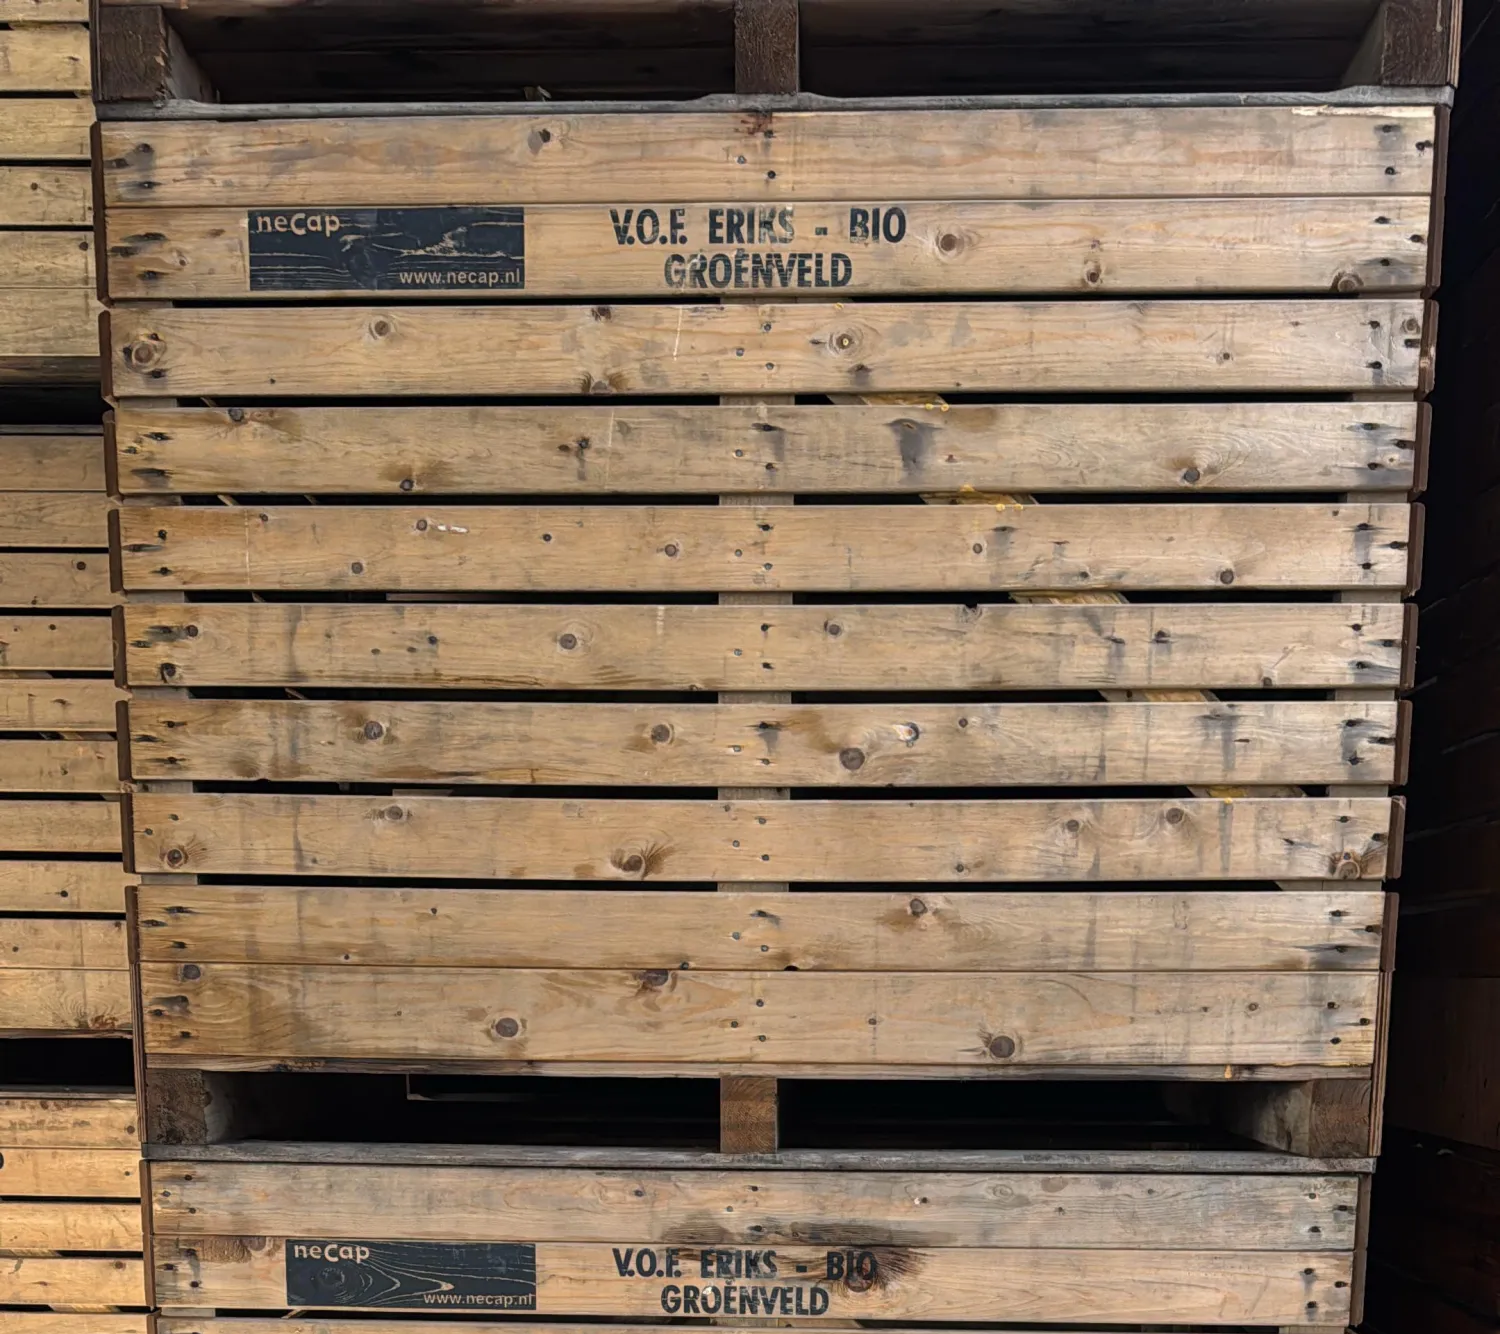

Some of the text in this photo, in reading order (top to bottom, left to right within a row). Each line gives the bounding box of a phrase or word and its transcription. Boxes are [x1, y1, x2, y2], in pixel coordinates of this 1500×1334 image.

[256, 213, 340, 236] neCap
[610, 207, 906, 245] V.O.F. ERIKS - BIO
[400, 268, 520, 286] www.necap.nl
[294, 1243, 370, 1263] neCap
[612, 1248, 682, 1277] V.O.F.
[700, 1249, 777, 1279] ERIKS
[826, 1251, 877, 1281] BIO
[424, 1293, 533, 1307] www.necap.nl
